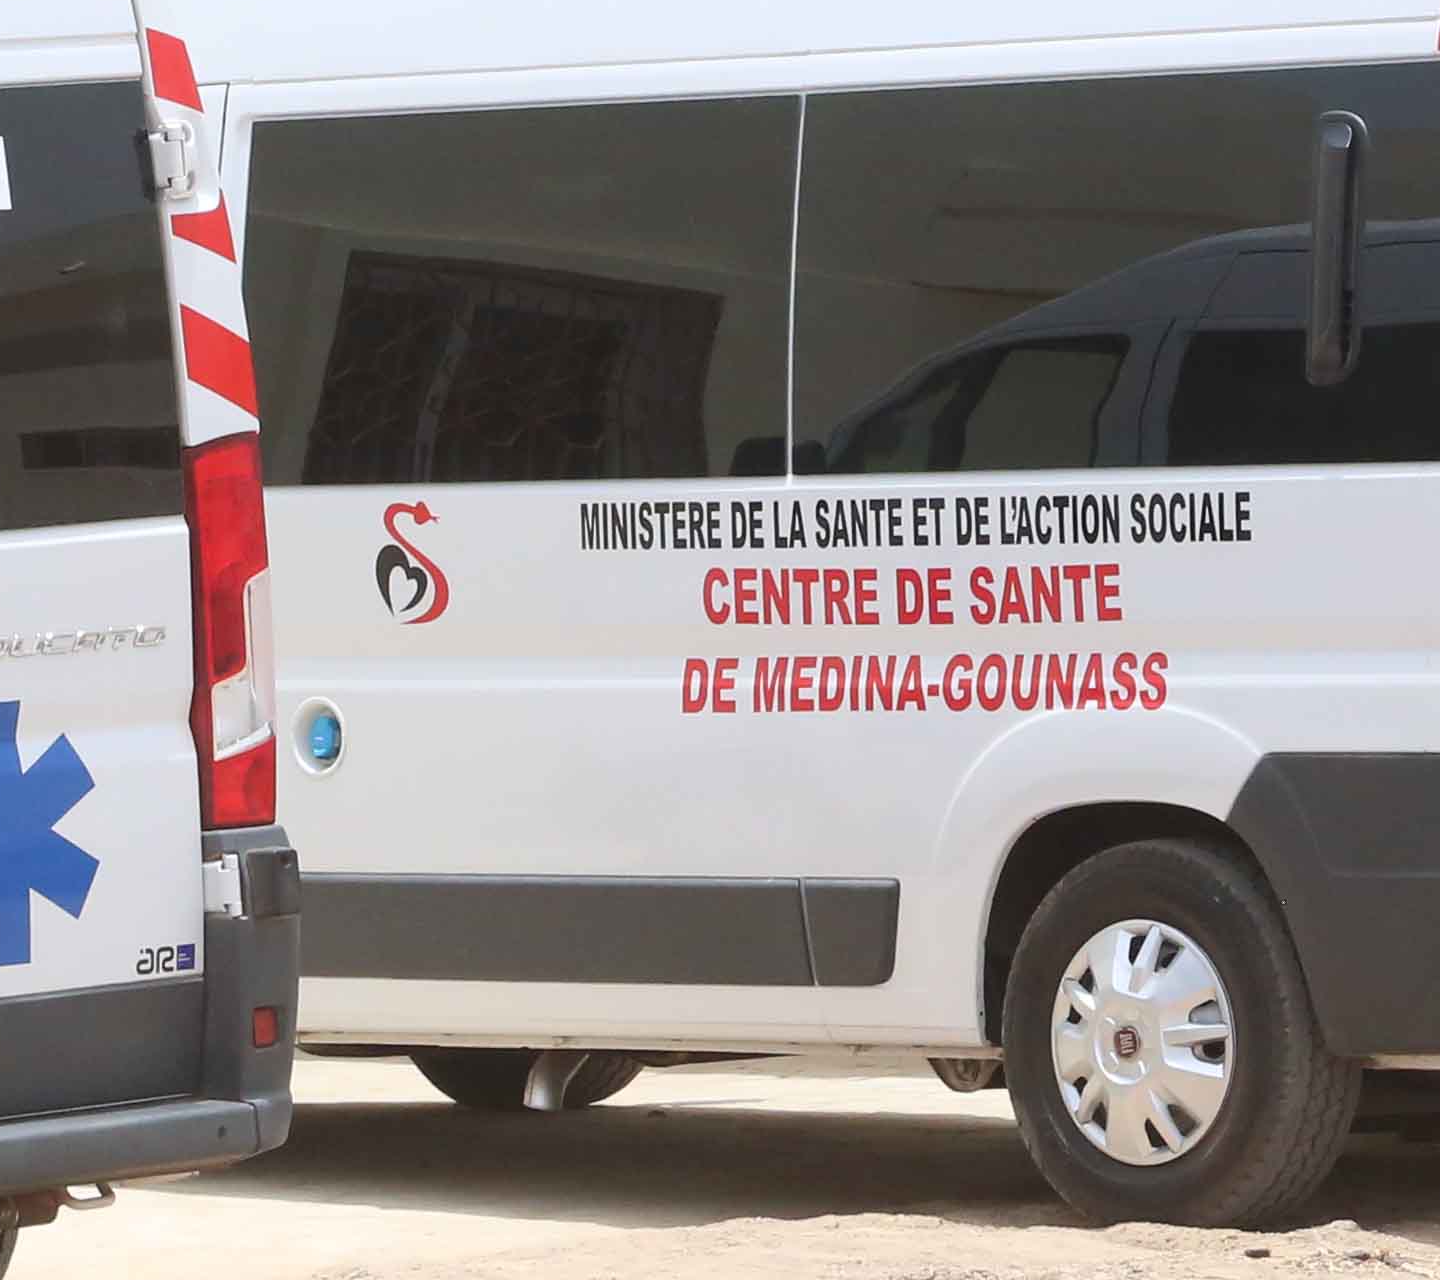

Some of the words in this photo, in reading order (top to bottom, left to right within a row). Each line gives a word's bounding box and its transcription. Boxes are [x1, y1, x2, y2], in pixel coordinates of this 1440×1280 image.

[580, 501, 722, 550] MINISTERE
[730, 500, 765, 549] DE
[773, 500, 807, 549] LA
[815, 498, 904, 549] SANTE
[912, 497, 946, 547] ET
[955, 496, 991, 546] DE
[999, 494, 1120, 545] L'ACTION
[1130, 491, 1252, 544] SOCIALE
[703, 567, 880, 625] CENTRE
[896, 566, 954, 625] DE
[970, 563, 1122, 625] SANTE
[682, 657, 739, 713] DE
[753, 651, 1168, 713] MEDINA-GOUNASS
